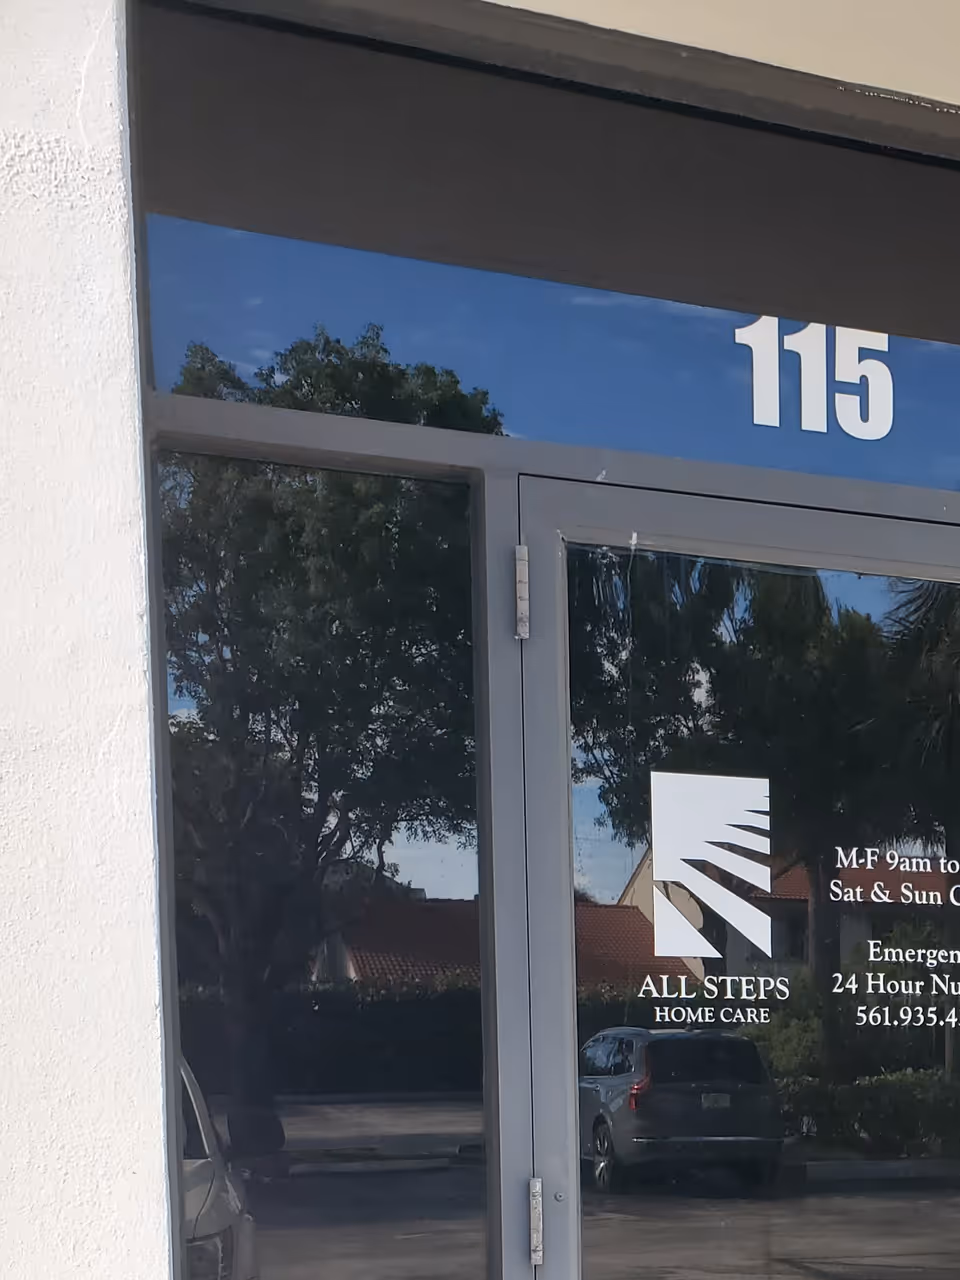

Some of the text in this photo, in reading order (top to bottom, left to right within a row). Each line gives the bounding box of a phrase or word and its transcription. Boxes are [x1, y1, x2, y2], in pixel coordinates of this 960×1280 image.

[735, 315, 894, 441] 115
[835, 846, 880, 870] M-F
[886, 850, 932, 873] 9am
[939, 857, 960, 874] to
[829, 880, 864, 902] Sat
[870, 881, 894, 903] &
[900, 883, 943, 905] Sun
[637, 974, 790, 1000] ALL STEPS
[832, 972, 859, 995] 24
[865, 972, 925, 995] Hour
[654, 1006, 771, 1024] HOME CARE
